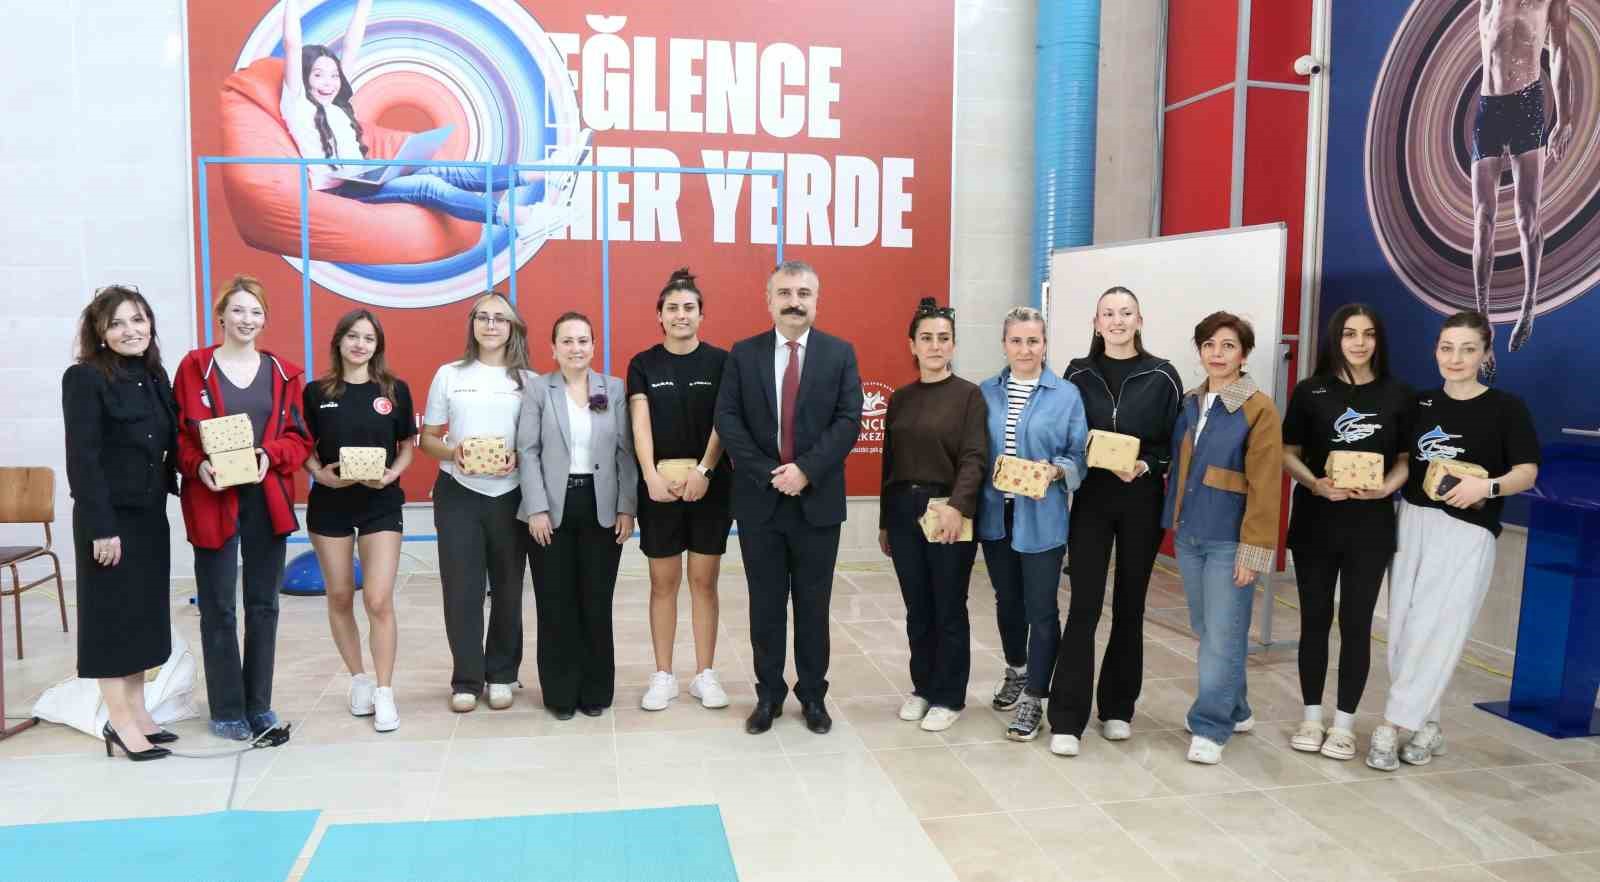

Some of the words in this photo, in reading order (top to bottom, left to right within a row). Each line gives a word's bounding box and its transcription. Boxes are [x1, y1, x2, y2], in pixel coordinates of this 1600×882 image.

[545, 15, 841, 138] EĞLENCE
[545, 145, 682, 242] HER
[700, 150, 915, 248] YERDE
